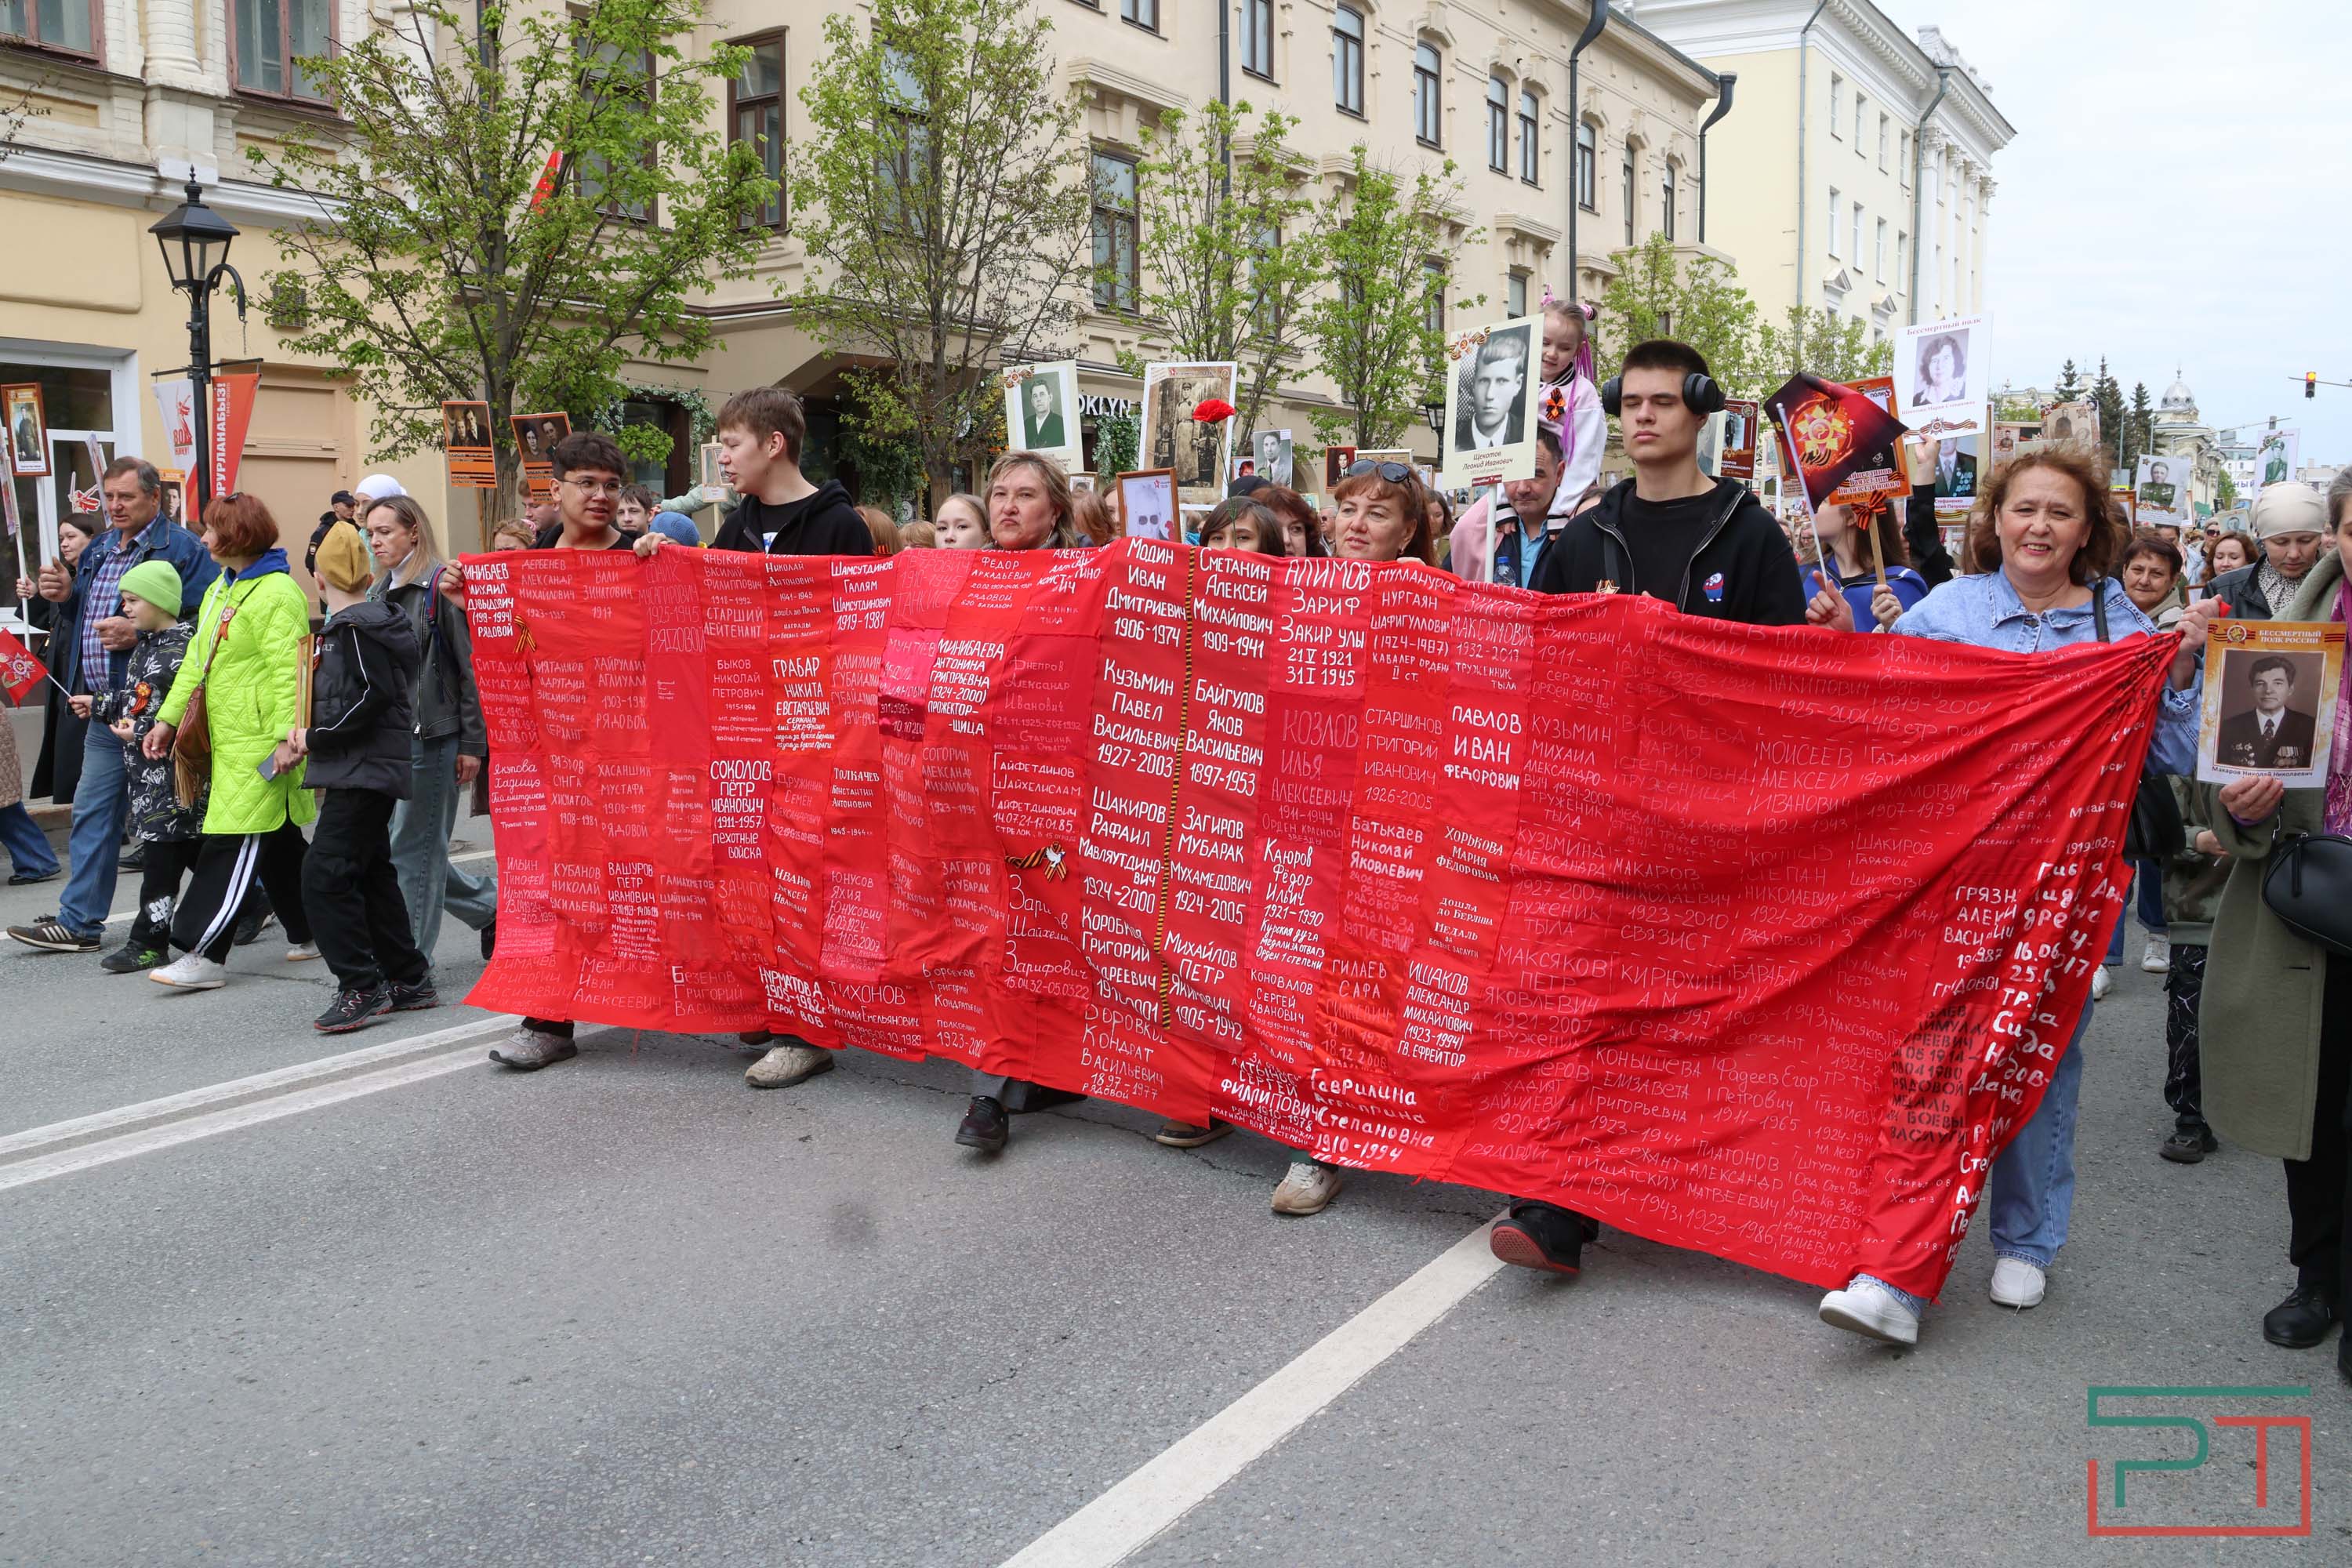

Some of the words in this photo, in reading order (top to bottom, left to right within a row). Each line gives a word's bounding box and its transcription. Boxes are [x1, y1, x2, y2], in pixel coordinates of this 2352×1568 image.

[1907, 322, 1960, 336] Бессмертный
[1962, 318, 1982, 326] полк
[1462, 462, 1484, 470] Леонид
[1485, 458, 1513, 466] Иванович
[1473, 451, 1501, 460] Щекотов
[703, 554, 748, 564] ЯНЫКИН
[1127, 538, 1174, 564] МОДИН
[706, 566, 745, 577] ВАСИЛИЙ
[766, 563, 804, 573] НИКОЛАЙ
[831, 561, 893, 577] ШАМСУТДИНОВ
[972, 569, 1031, 579] АРКАДЬЕВИЧ
[1200, 547, 1270, 582] СМЕТАНИН
[1284, 559, 1371, 591] АЛИМОВ
[521, 575, 572, 586] АЛЕКСАНДР
[703, 579, 762, 590] ФИЛИППОВИЧ
[768, 576, 815, 587] АНТОНОВИЧ
[844, 579, 877, 593] ГАЛЛЯМ
[1128, 564, 1166, 590] ИВАН
[1205, 574, 1268, 603] АЛЕКСЕЙ
[1377, 568, 1456, 593] МУЛЛАНУРОВ
[833, 597, 891, 613] ШАМСУТДИНОВИЧ
[1105, 586, 1186, 620] ДМИТРИЕВИЧ
[1291, 587, 1360, 615] ЗАРИФ
[1381, 590, 1438, 610] НУРГАЯН
[707, 608, 764, 622] СТАРШИЙ
[1193, 597, 1273, 635] МИХАЙЛОВИЧ
[478, 626, 513, 637] РЯДОВОЙ
[705, 622, 761, 638] ЛЕЙТЕНАНТ
[1114, 617, 1181, 648] 1906-1974
[1450, 615, 1534, 648] МАКСИМОВИЧ
[2259, 630, 2321, 638] БЕССМЕРТНЫЙ
[938, 639, 1004, 660] МИНИБАЕВА
[1201, 631, 1265, 659] 1909-1941
[1373, 635, 1449, 657] (1924-1987)
[717, 659, 751, 670] БЫКОВ
[772, 657, 820, 677] ГРАБАР
[933, 658, 985, 672] АНТОНИНА
[714, 672, 760, 684] НИКОЛАЙ
[930, 671, 989, 688] ГРИГОРЬЕВНА
[1103, 658, 1174, 696] КУЗЬМИН
[1491, 680, 1516, 691] ТЫЛА
[713, 689, 764, 699] ПЕТРОВИЧ
[785, 683, 822, 698] НИКИТА
[1195, 679, 1265, 714] БАЙГУЛОВ
[776, 701, 829, 716] ЕВСТАФЬЕВИЧ
[1112, 692, 1163, 722] ПАВЕЛ
[1206, 710, 1243, 737] ЯКОВ
[1283, 710, 1359, 748] КОЗЛОВ
[1365, 708, 1442, 735] СТАРШИНОВ
[1451, 706, 1522, 734] ПАВЛОВ
[1531, 714, 1611, 745] КУЗЬМИН
[1620, 714, 1745, 744] ВАСИЛЬЕВА
[1093, 714, 1179, 753] ВАСИЛЬЕВИЧ
[923, 747, 969, 761] СОГОРИН
[1185, 729, 1263, 767] ВАСИЛЬЕВИЧ
[1366, 735, 1439, 761] ГРИГОРИЙ
[1454, 734, 1511, 764] ИВАН
[1531, 739, 1595, 765] МИХАИЛ
[710, 760, 771, 780] СОКОЛОВ
[921, 765, 972, 778] АЛЕКСАНДР
[993, 753, 1075, 778] ГАЙФЕТДИНОВ
[1098, 743, 1174, 778] 1927-2003
[1281, 749, 1323, 781] ИЛЬЯ
[2212, 766, 2241, 775] Макаров
[833, 768, 880, 782] ТОЛКАЧЕВ
[993, 772, 1080, 796] ШАЙХЕЛИСЛАМ
[1190, 763, 1255, 797] 1897-1953
[1365, 761, 1436, 786] ИВАНОВИЧ
[1443, 764, 1520, 791] ФЕДОРОВИЧ
[601, 784, 644, 796] МУСТАФА
[720, 779, 755, 797] ПЁТР
[832, 785, 873, 797] КОНСТАНТИН
[924, 779, 979, 796] МИХАЙЛОВИЧ
[1272, 778, 1353, 808] АЛЕКСЕЕВИЧ
[1365, 786, 1433, 809] 1926-2005
[712, 798, 764, 814] ИВАНОВИЧ
[832, 797, 873, 808] АНТОНОВИЧ
[992, 792, 1077, 816] ГАЙФЕТДИНОВИЧ
[1093, 786, 1167, 823] ШАКИРОВ
[1091, 813, 1150, 848] РАФАИЛ
[1181, 805, 1243, 840] ЗАГИРОВ
[728, 844, 761, 858] ВОЙСКА
[1178, 833, 1244, 864] МУБАРАК
[1444, 826, 1504, 857] ХОРЬКОВА
[1517, 826, 1606, 859] КУЗЬМИНА
[507, 857, 537, 871] ИЛЬИН
[1078, 837, 1165, 875] МАВЛЯУТДИНО-
[1452, 845, 1487, 868] МАРИЯ
[1513, 847, 1606, 879] АЛЕКСАНДРА
[554, 862, 601, 879] КУБАНОВ
[608, 862, 653, 877] ВАШУРОВ
[775, 867, 811, 889] ИВАНОВ
[832, 871, 873, 888] ЮНУСОВ
[942, 862, 991, 876] ЗАГИРОВ
[1134, 872, 1156, 887] ВИЧ
[1170, 861, 1252, 895] МУХАМЕДОВИЧ
[1613, 857, 1700, 881] МАКАРОВ
[552, 880, 601, 895] НИКОЛАЙ
[617, 877, 644, 888] ПЕТР
[832, 886, 862, 902] ЯХИЯ
[946, 879, 989, 893] МУБАРАК
[608, 891, 655, 903] ИВАНОВИЧ
[1174, 889, 1246, 925] 1924-2005
[829, 900, 882, 921] ЮНУСОВИЧ
[1264, 904, 1324, 927] 1921-1990
[1628, 905, 1730, 930] 1923-2010
[1435, 922, 1478, 941] МЕДАЛЬ
[1621, 924, 1713, 951] СВЯЗИСТ
[1082, 931, 1150, 962] ГРИГОРИЙ
[1163, 930, 1237, 968] МИХАЙЛОВ
[1179, 958, 1225, 985] ПЕТР
[1332, 958, 1387, 978] ГИЛАЕВ
[1497, 944, 1608, 978] МАКСЯКОВ
[579, 974, 614, 989] ИВАН
[759, 966, 812, 997] НУРМАТОВ
[1250, 969, 1312, 996] КОНОВАЛОВ
[1409, 960, 1468, 996] ИШАКОВ
[1520, 971, 1576, 992] ПЕТР
[1621, 964, 1722, 991] КИРЮХИН
[572, 987, 662, 1009] АЛЕКСЕЕВИЧ
[828, 981, 906, 1005] ТИХОНОВ
[1256, 989, 1297, 1009] СЕРГЕЙ
[1338, 981, 1381, 999] САФА
[1406, 985, 1470, 1015] АЛЕКСАНДР
[1485, 985, 1599, 1015] ЯКОВЛЕВИЧ
[1175, 1006, 1243, 1040] 1905-1942
[1403, 1005, 1473, 1035] МИХАЙЛОВИЧ
[1082, 1023, 1154, 1062] КОНДРАТ
[1081, 1048, 1164, 1091] ВАСИЛЬЕВИЧ
[1892, 1076, 1965, 1097] РЯДОВОЙ
[1697, 1139, 1780, 1172] ПЛАТОНОВ
[1689, 1162, 1784, 1192] АЛЕКСАНДР
[1686, 1181, 1781, 1218] МАТВЕЕВИЧ
